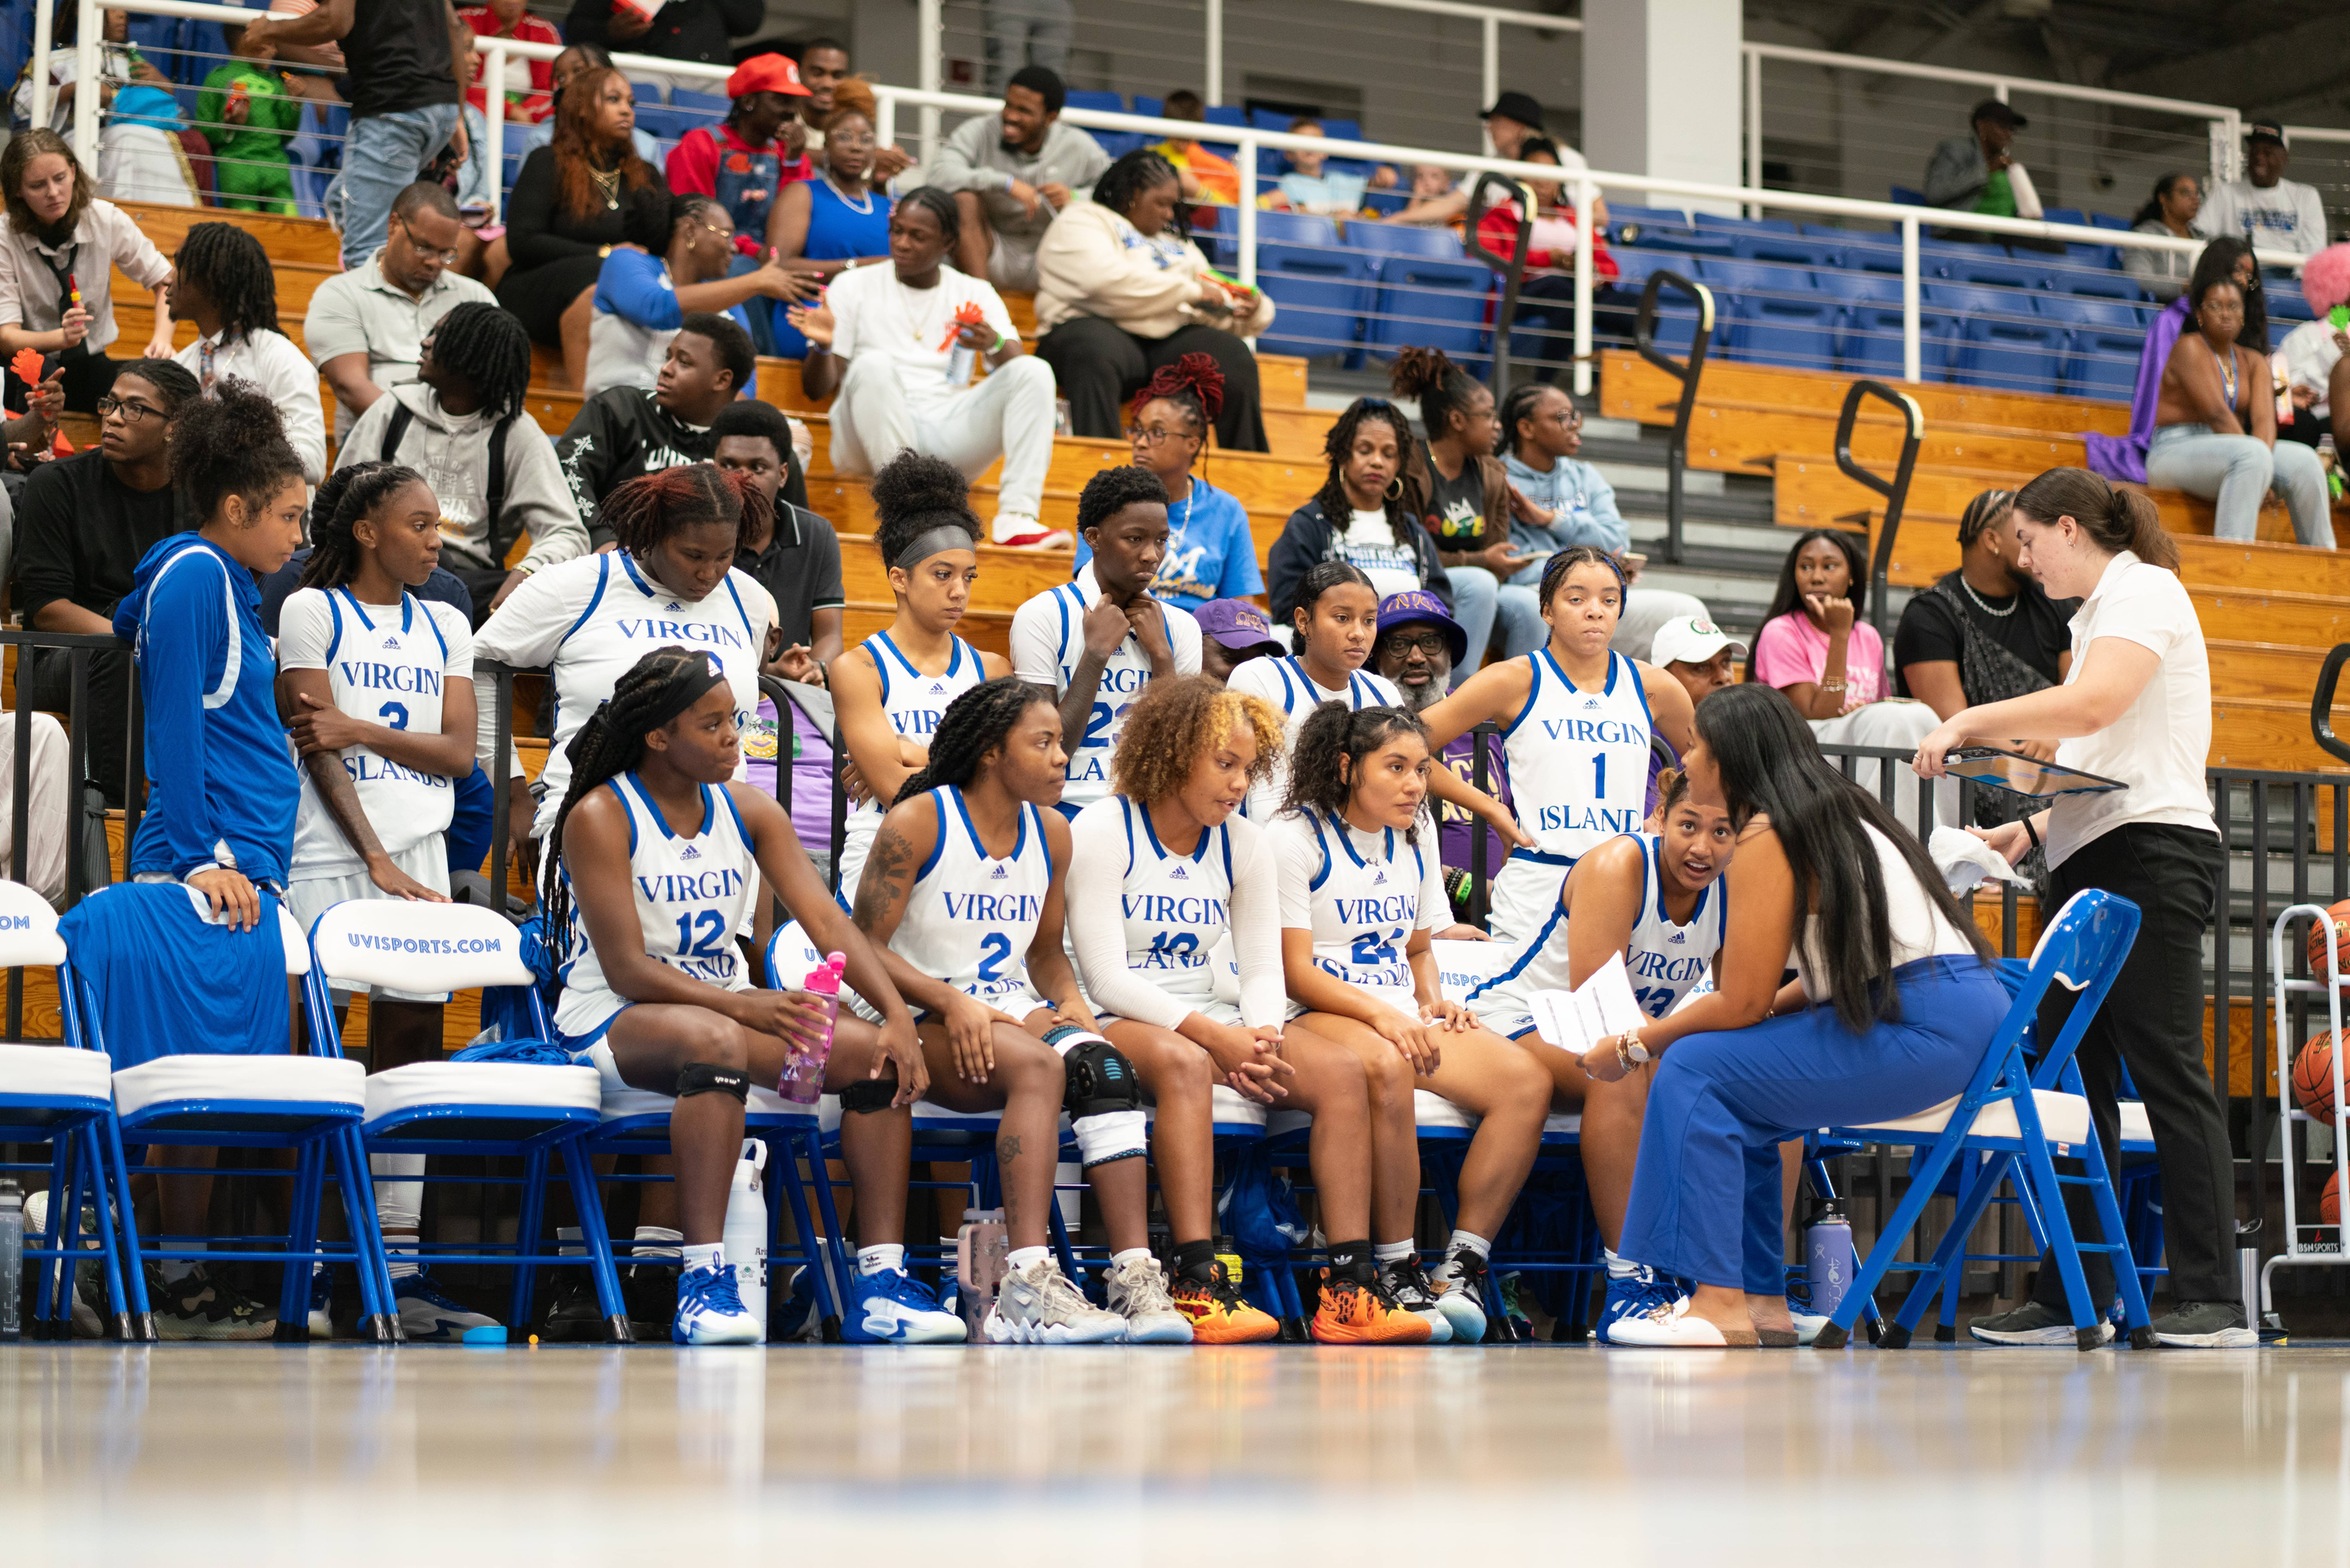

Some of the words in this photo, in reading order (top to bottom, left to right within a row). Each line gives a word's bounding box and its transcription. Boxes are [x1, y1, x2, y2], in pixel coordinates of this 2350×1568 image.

[616, 618, 742, 650] VIRGIN
[341, 661, 440, 697] VIRGIN
[1541, 719, 1647, 749] VIRGIN
[1592, 753, 1606, 799] 1
[680, 853, 702, 861] adidas
[637, 868, 743, 903] VIRGIN
[943, 891, 1041, 922] VIRGIN
[1121, 893, 1227, 925] VIRGIN
[1334, 895, 1415, 925] VIRGIN
[347, 932, 502, 954] UVISPORTS.COM
[676, 909, 726, 958] 12
[1351, 927, 1405, 965] 24
[977, 932, 1012, 983] 2
[1625, 943, 1712, 981] VIRGIN
